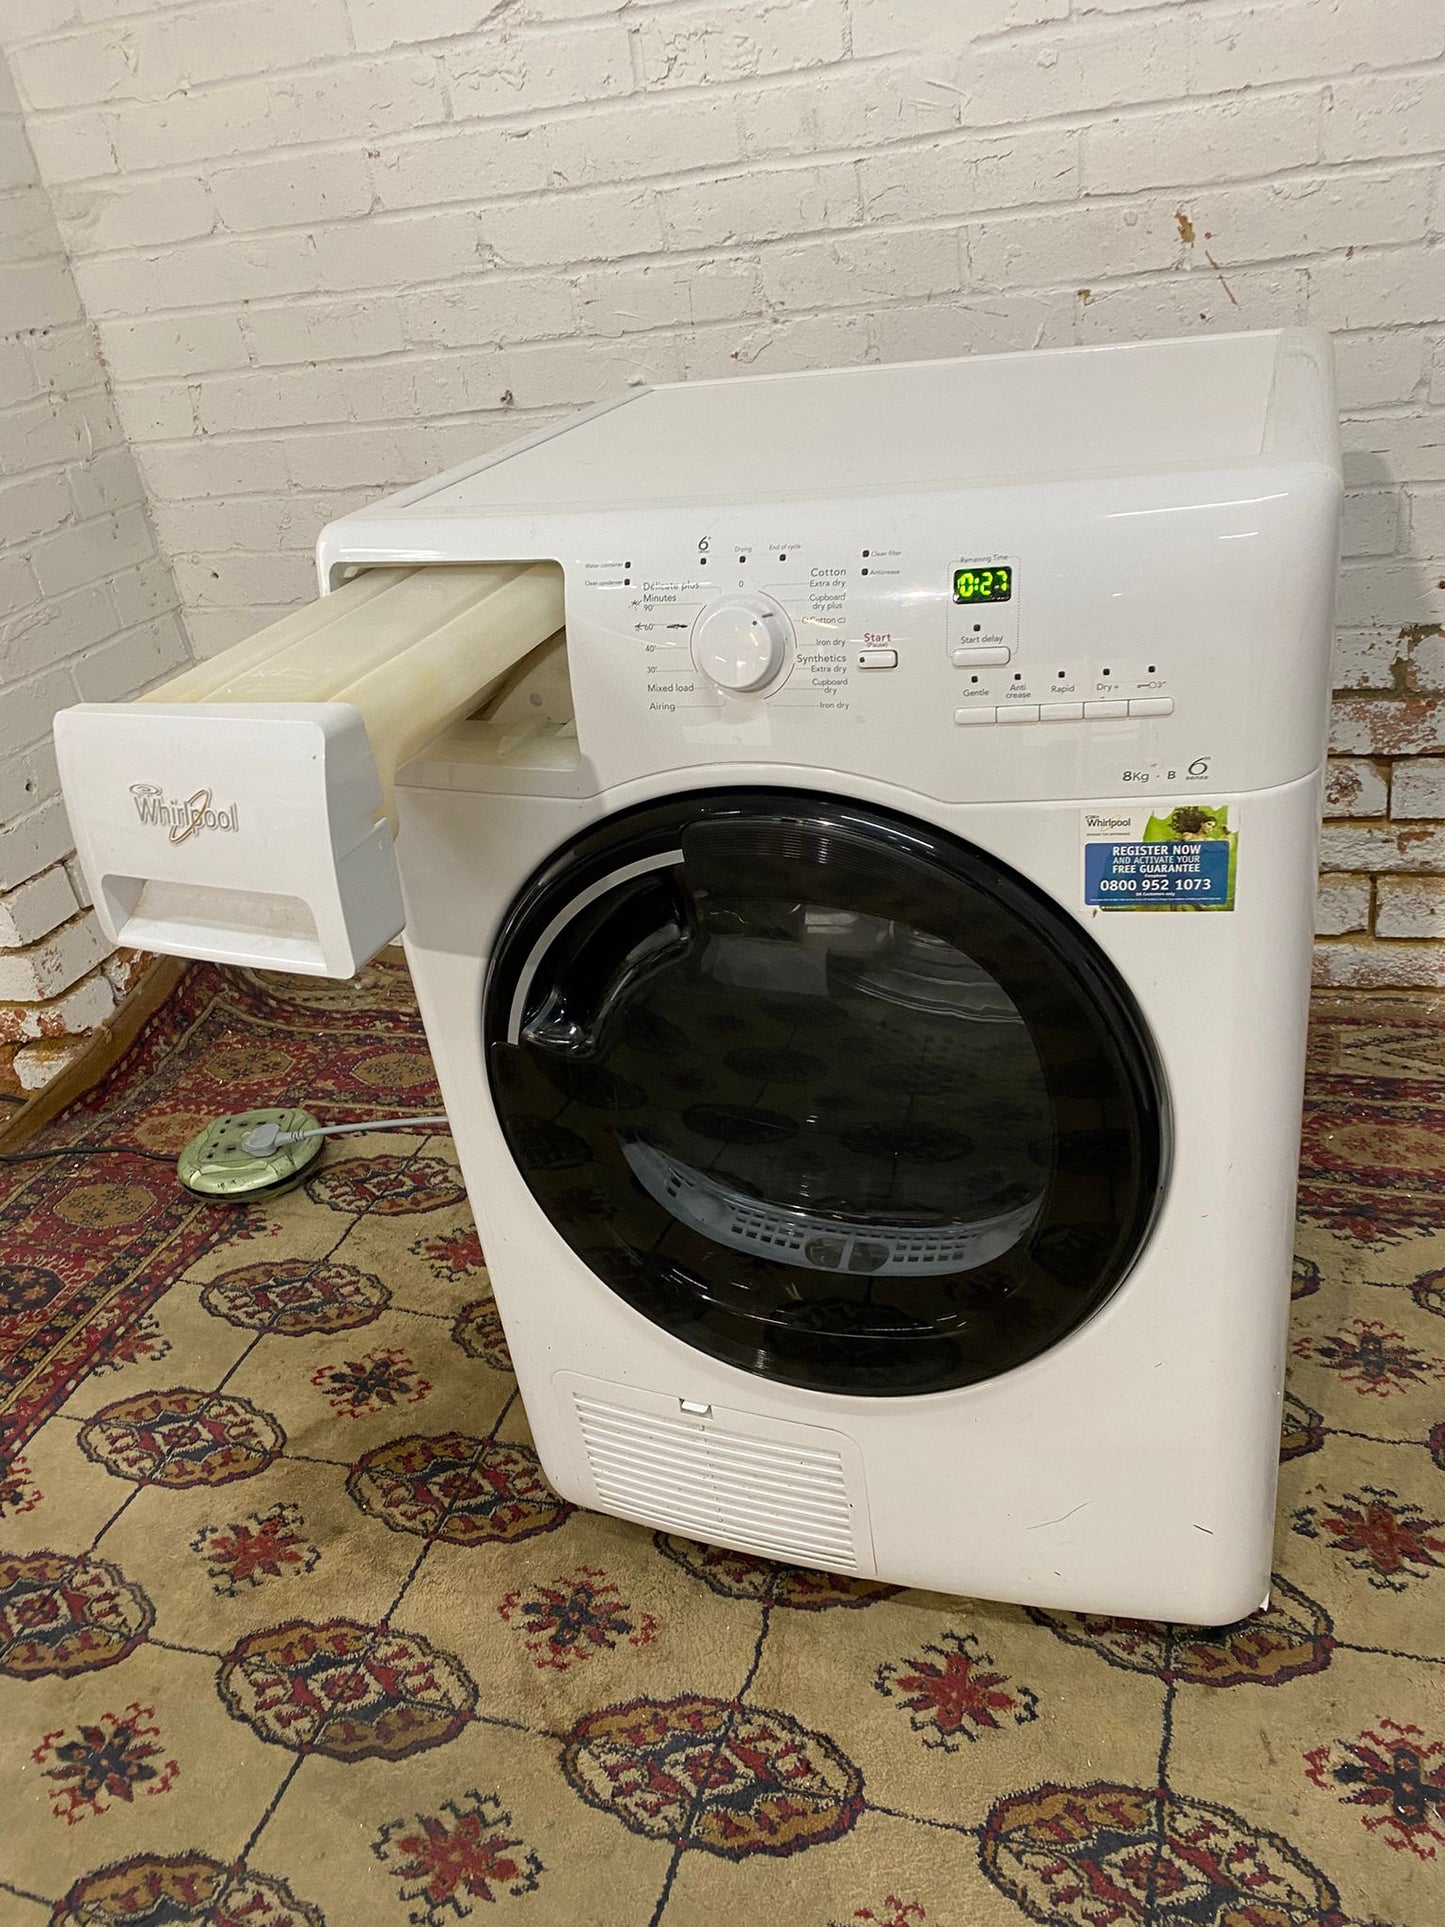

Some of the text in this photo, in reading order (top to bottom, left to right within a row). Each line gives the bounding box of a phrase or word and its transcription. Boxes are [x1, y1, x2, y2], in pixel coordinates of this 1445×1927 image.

[993, 553, 1008, 561] Time
[810, 567, 847, 577] Cotton
[809, 579, 846, 588] Extra dry
[957, 570, 1008, 597] 0:27
[643, 594, 677, 602] Minutes
[809, 593, 846, 603] Cupboard
[812, 602, 843, 611] dry plus
[864, 632, 892, 643] Start
[960, 634, 1004, 645] Start delay
[816, 638, 846, 648] Iron dry
[796, 653, 847, 666] Synthetics
[810, 665, 847, 675] Extra dry
[812, 677, 848, 687] Cupboard
[647, 683, 694, 693] Mixed load
[823, 686, 837, 695] dry
[963, 688, 990, 698] Gentle
[1010, 684, 1027, 693] Anti
[1051, 685, 1076, 695] Rapid
[1005, 692, 1031, 700] crease
[649, 701, 676, 711] Airing
[819, 700, 850, 710] Iron dry
[1122, 770, 1177, 783] 8Kg B
[133, 796, 239, 836] Whirlpool
[1086, 817, 1131, 829] Whirlpool
[1112, 844, 1202, 857] REGISTER NOW
[1112, 854, 1201, 865] AND ACTIVATE YOUR
[1112, 863, 1201, 874] FREE GUARANTEE
[1100, 878, 1212, 891] 0800 952 1073
